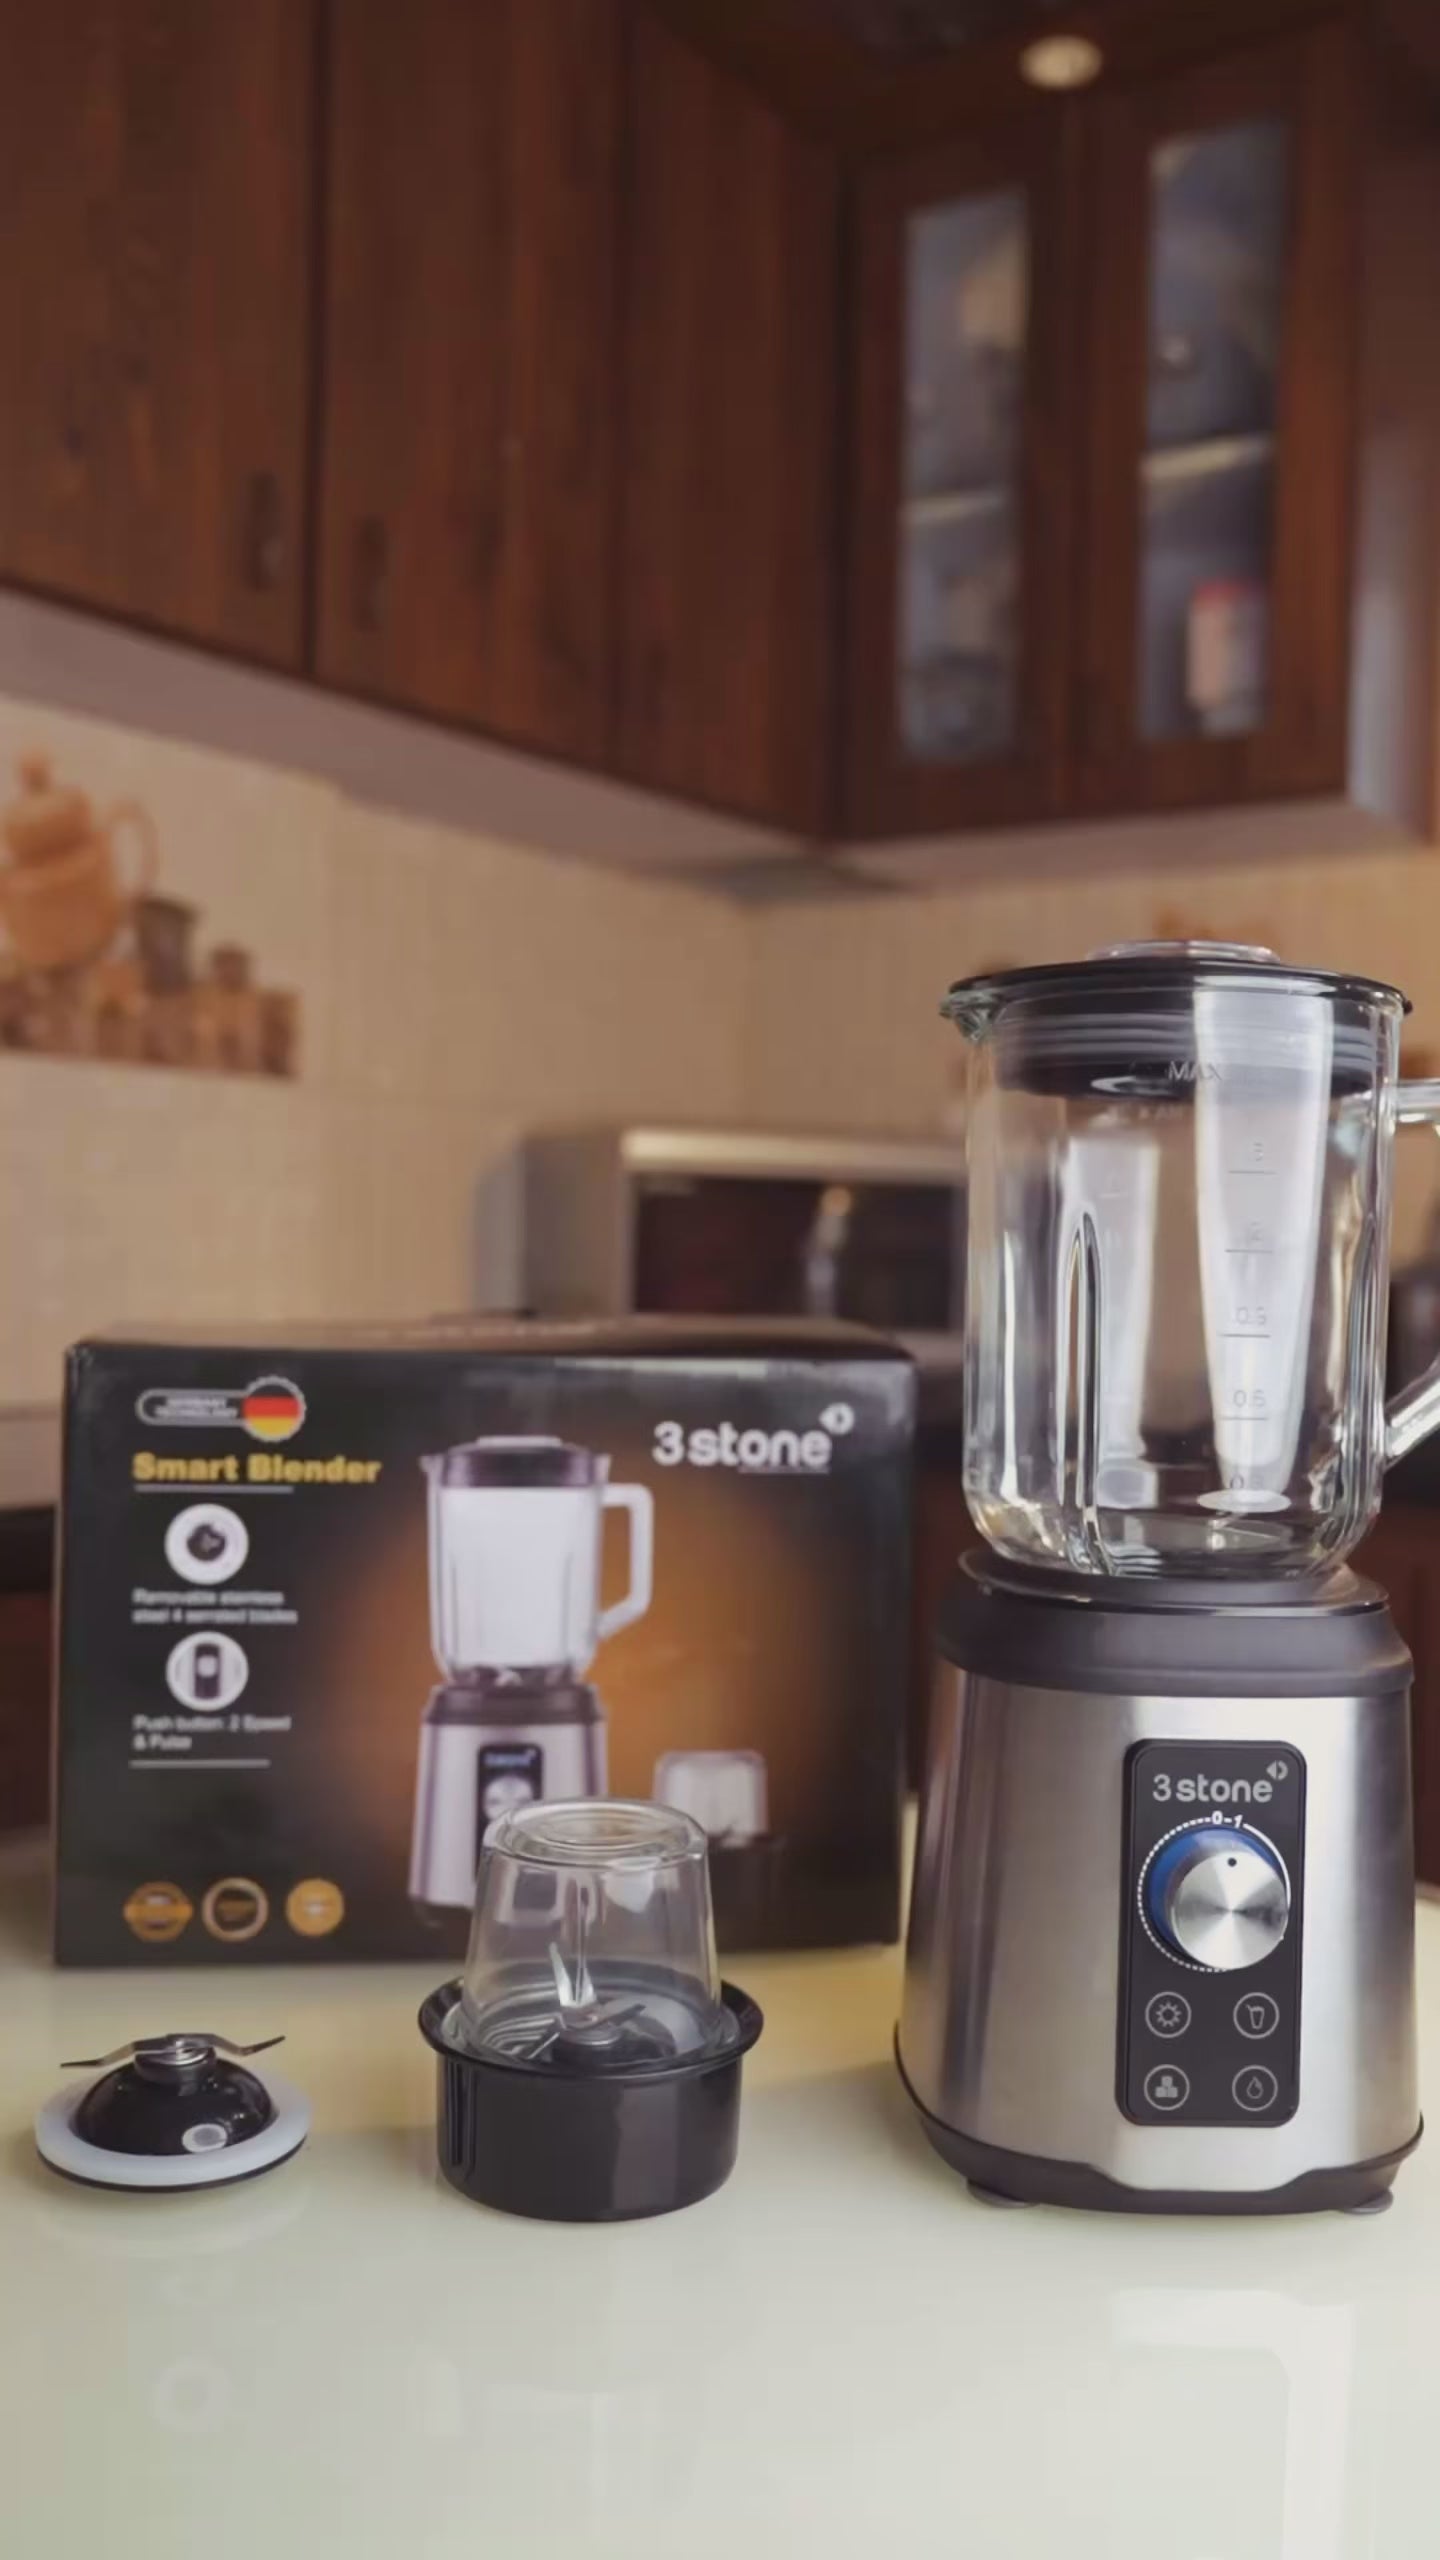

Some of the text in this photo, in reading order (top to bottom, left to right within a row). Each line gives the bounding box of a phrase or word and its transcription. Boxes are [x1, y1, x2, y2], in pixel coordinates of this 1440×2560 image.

[1168, 1061, 1222, 1081] MAX
[652, 1420, 832, 1466] 3 stone
[132, 1452, 382, 1483] Smart Blender
[1152, 1773, 1273, 1803] 3 stone
